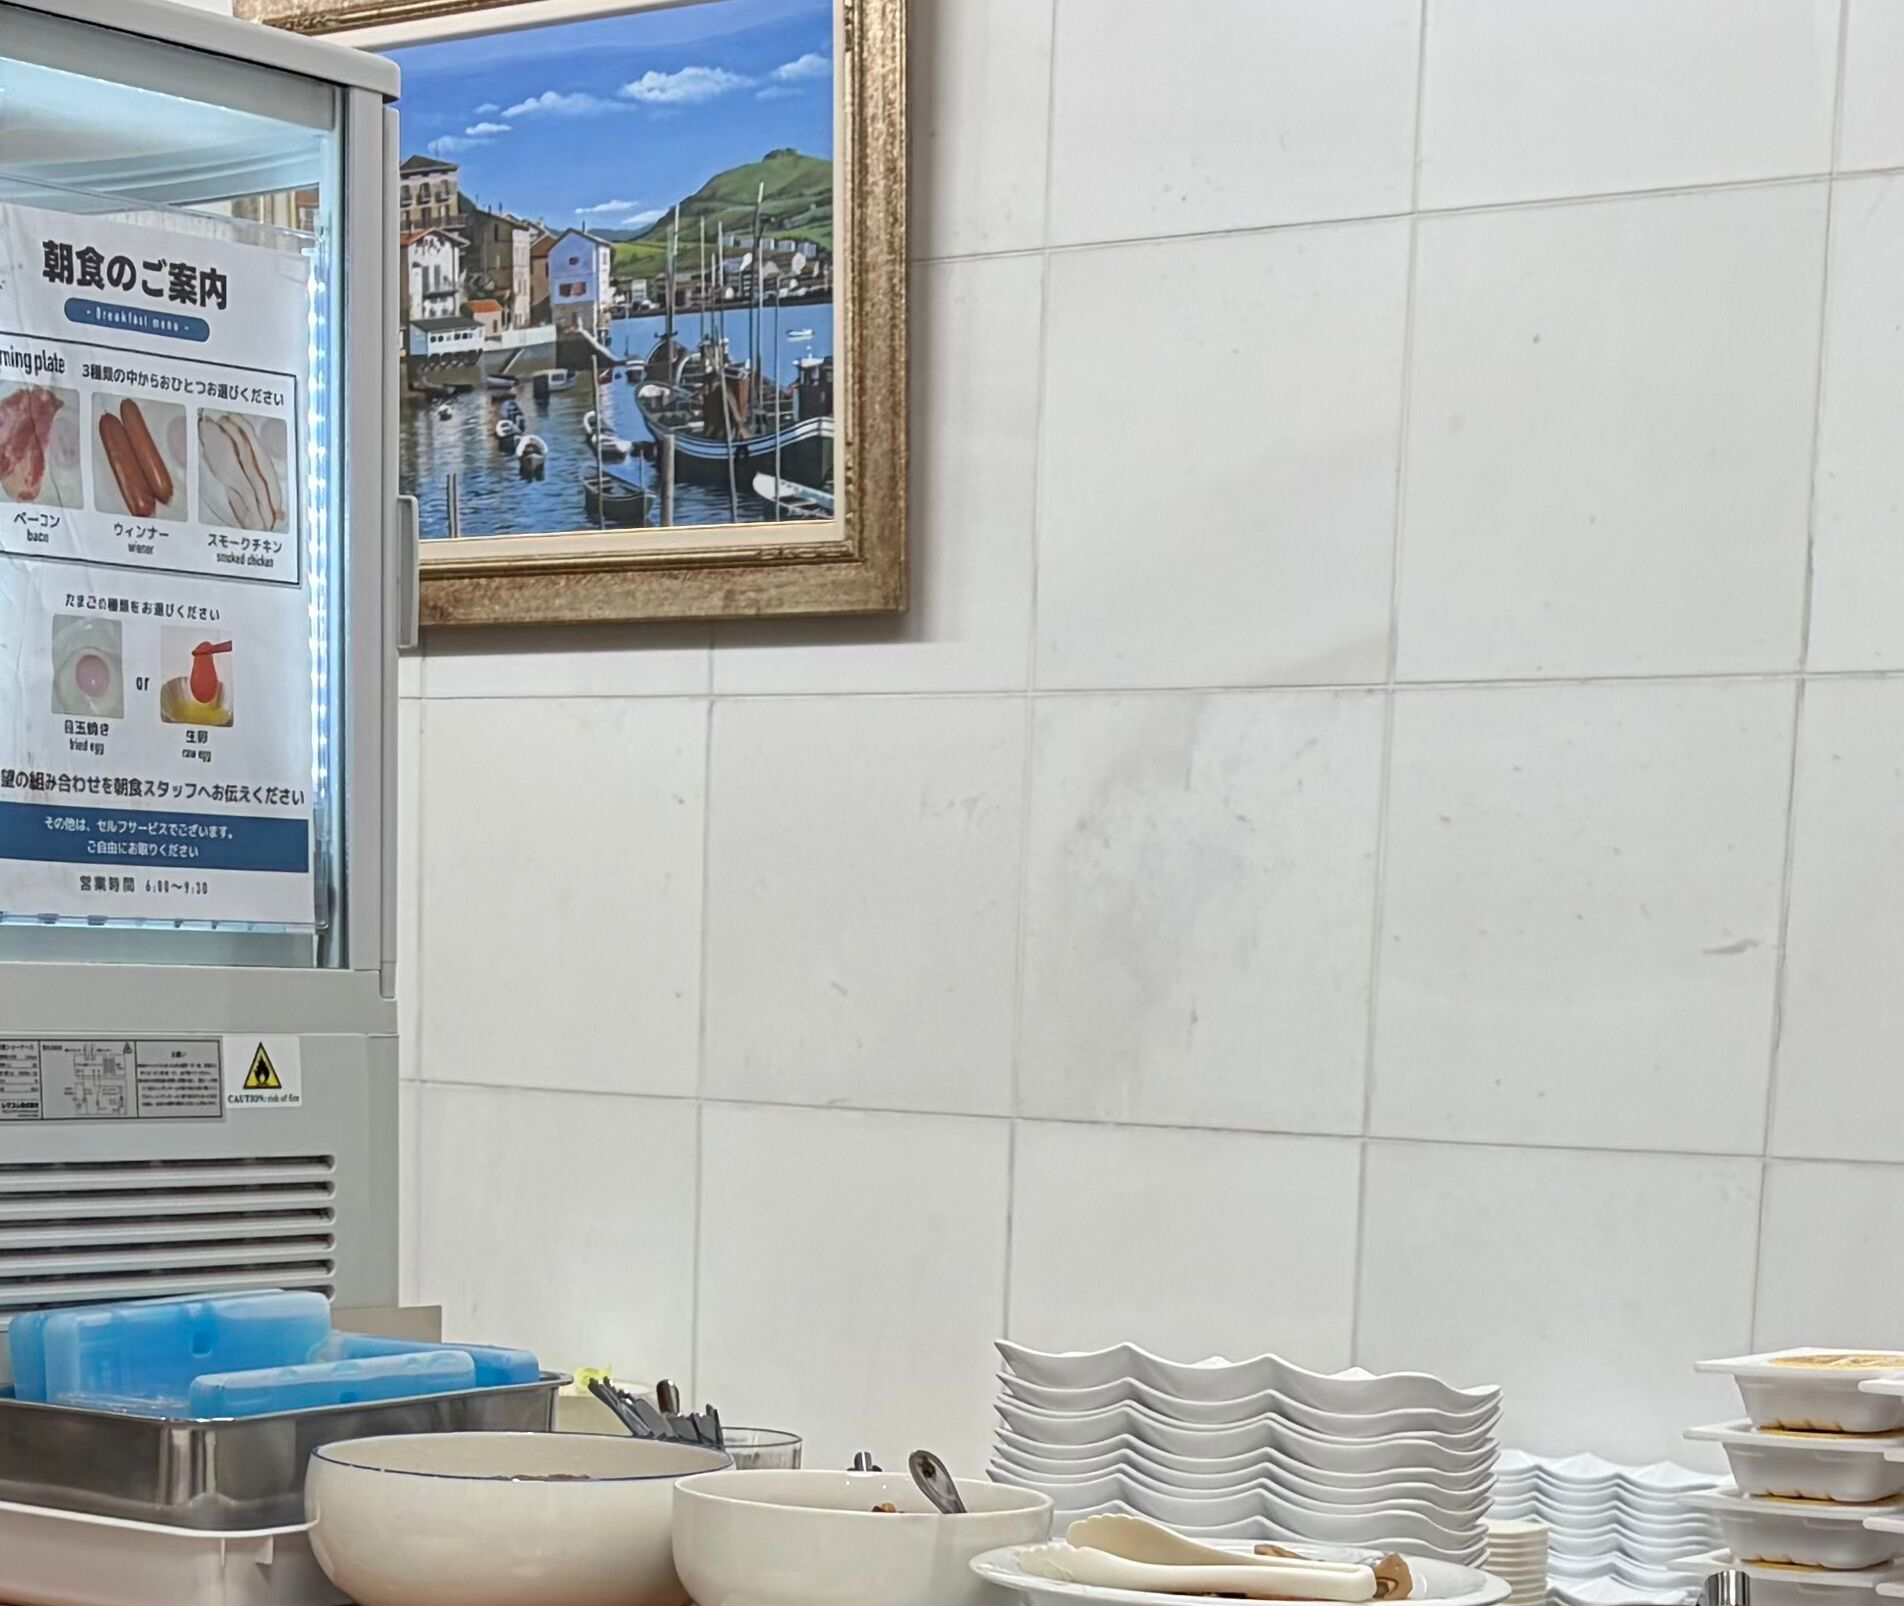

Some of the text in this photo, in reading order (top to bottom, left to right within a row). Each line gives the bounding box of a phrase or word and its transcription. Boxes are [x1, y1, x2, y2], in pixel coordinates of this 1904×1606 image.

[42, 240, 228, 310] 朝食のご案内
[34, 349, 66, 375] plate
[14, 511, 61, 529] ベーコン
[113, 523, 170, 540] ウィンナー
[207, 533, 283, 553] スモークチキン
[136, 677, 150, 692] or
[87, 840, 199, 859] ご自由にお取りください
[80, 875, 135, 893] 営業時間
